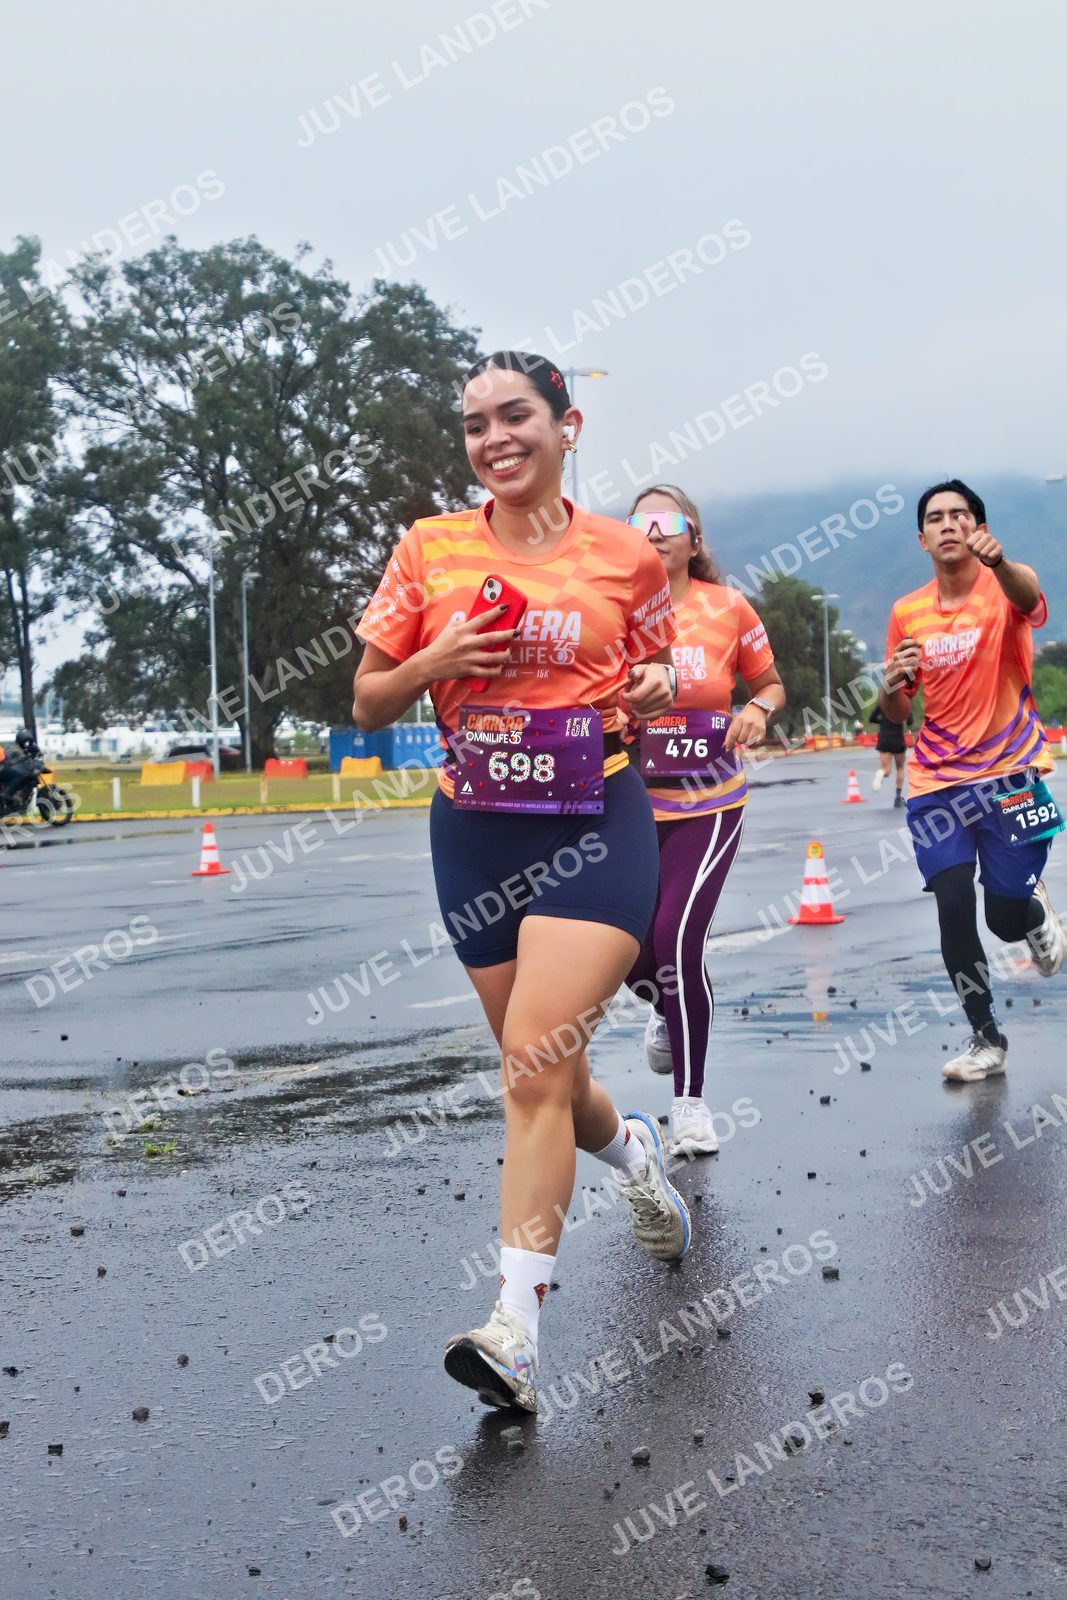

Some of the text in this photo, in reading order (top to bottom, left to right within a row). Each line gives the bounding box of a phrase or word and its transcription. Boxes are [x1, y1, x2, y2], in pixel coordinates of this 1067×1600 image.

[466, 713, 524, 732] CARRERA
[565, 717, 592, 737] 15K
[665, 738, 708, 758] 476
[488, 751, 556, 783] 698
[1015, 802, 1058, 829] 1592
